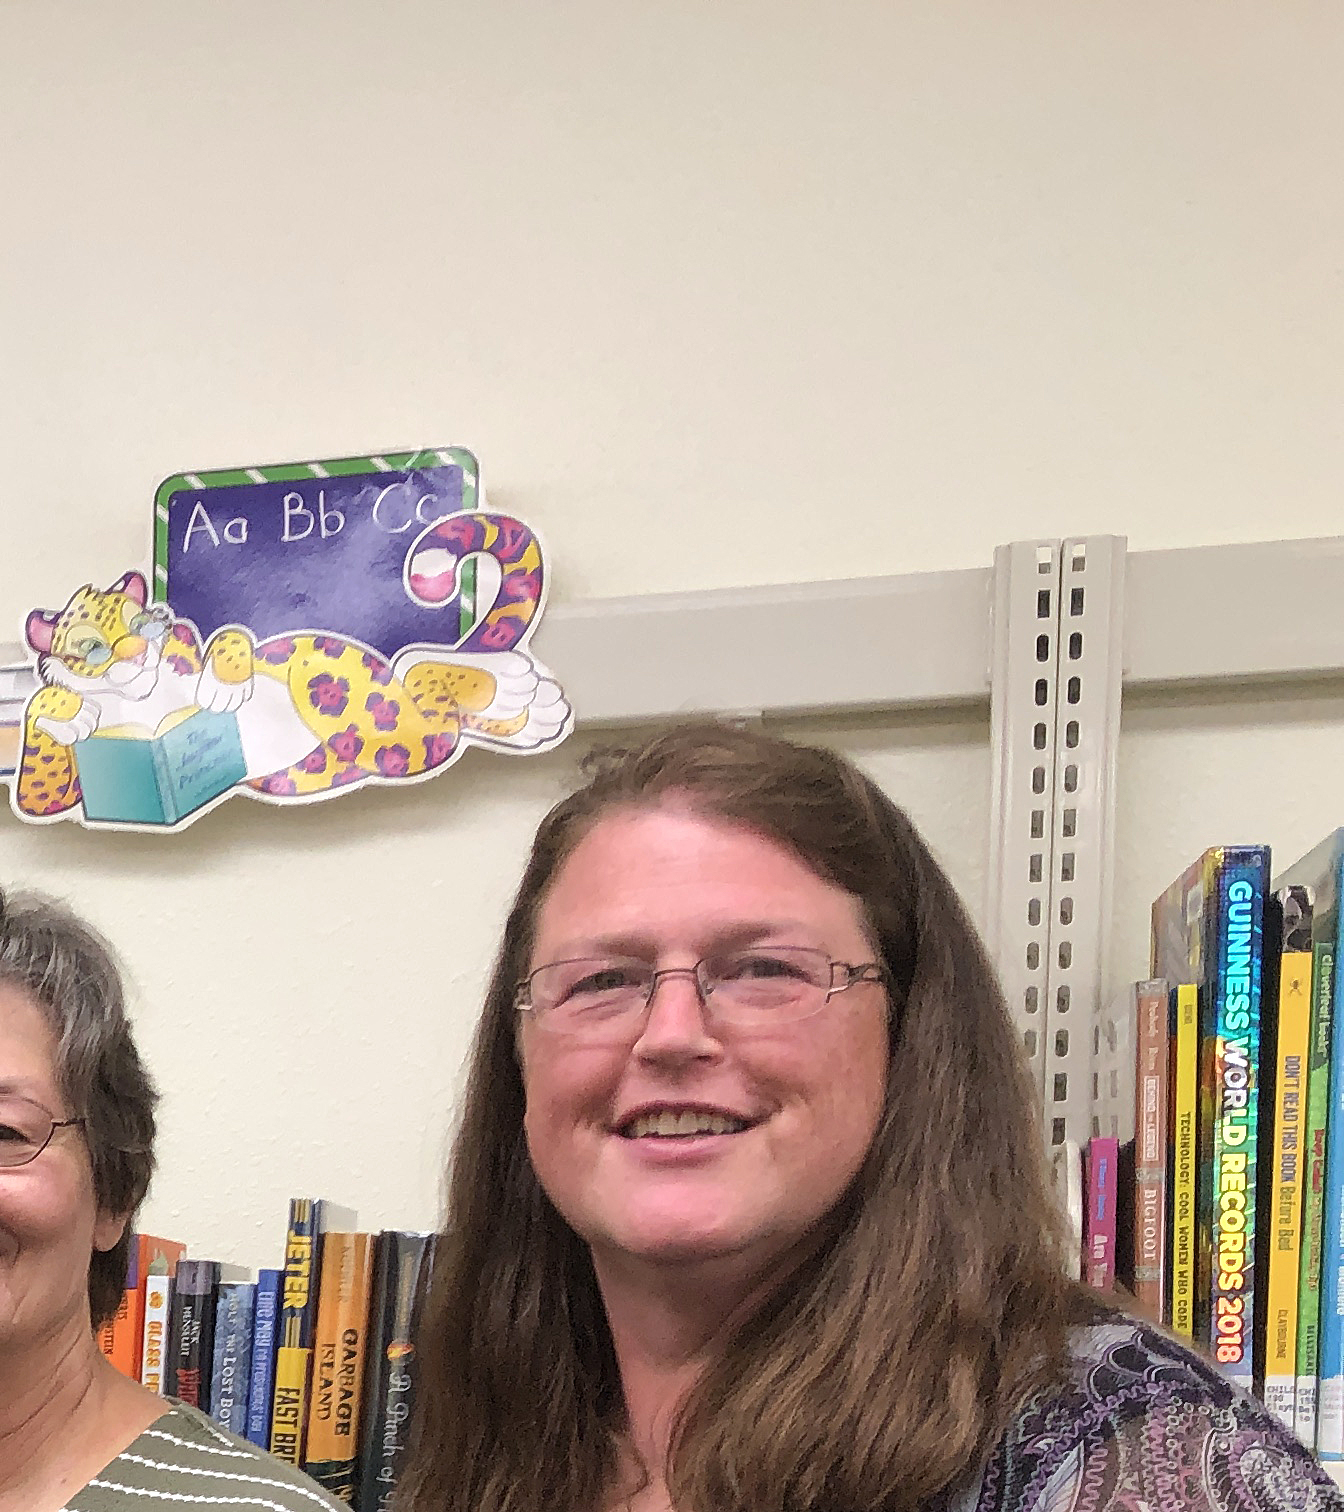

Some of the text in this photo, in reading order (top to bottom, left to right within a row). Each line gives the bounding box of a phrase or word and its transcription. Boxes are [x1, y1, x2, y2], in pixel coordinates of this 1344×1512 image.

[182, 481, 440, 553] Aa Bb Cc
[1217, 881, 1253, 1363] GUINNESS WORLD RECORDS 2018
[1281, 1056, 1300, 1183] DON'T READ THIS BOOK
[1143, 1189, 1156, 1260] BIGFOOT
[1176, 1111, 1192, 1329] TECHNOLOGY: COOL WOMEN WHO CODE
[1278, 1187, 1295, 1224] Before
[282, 1230, 312, 1309] JETER
[221, 1357, 237, 1395] LOST
[275, 1387, 300, 1428] FAST
[316, 1343, 336, 1421] ISLAND
[334, 1329, 359, 1436] GARBAGE
[219, 1398, 232, 1428] BOY
[380, 1403, 409, 1457] Pinch
[376, 1466, 398, 1484] of
